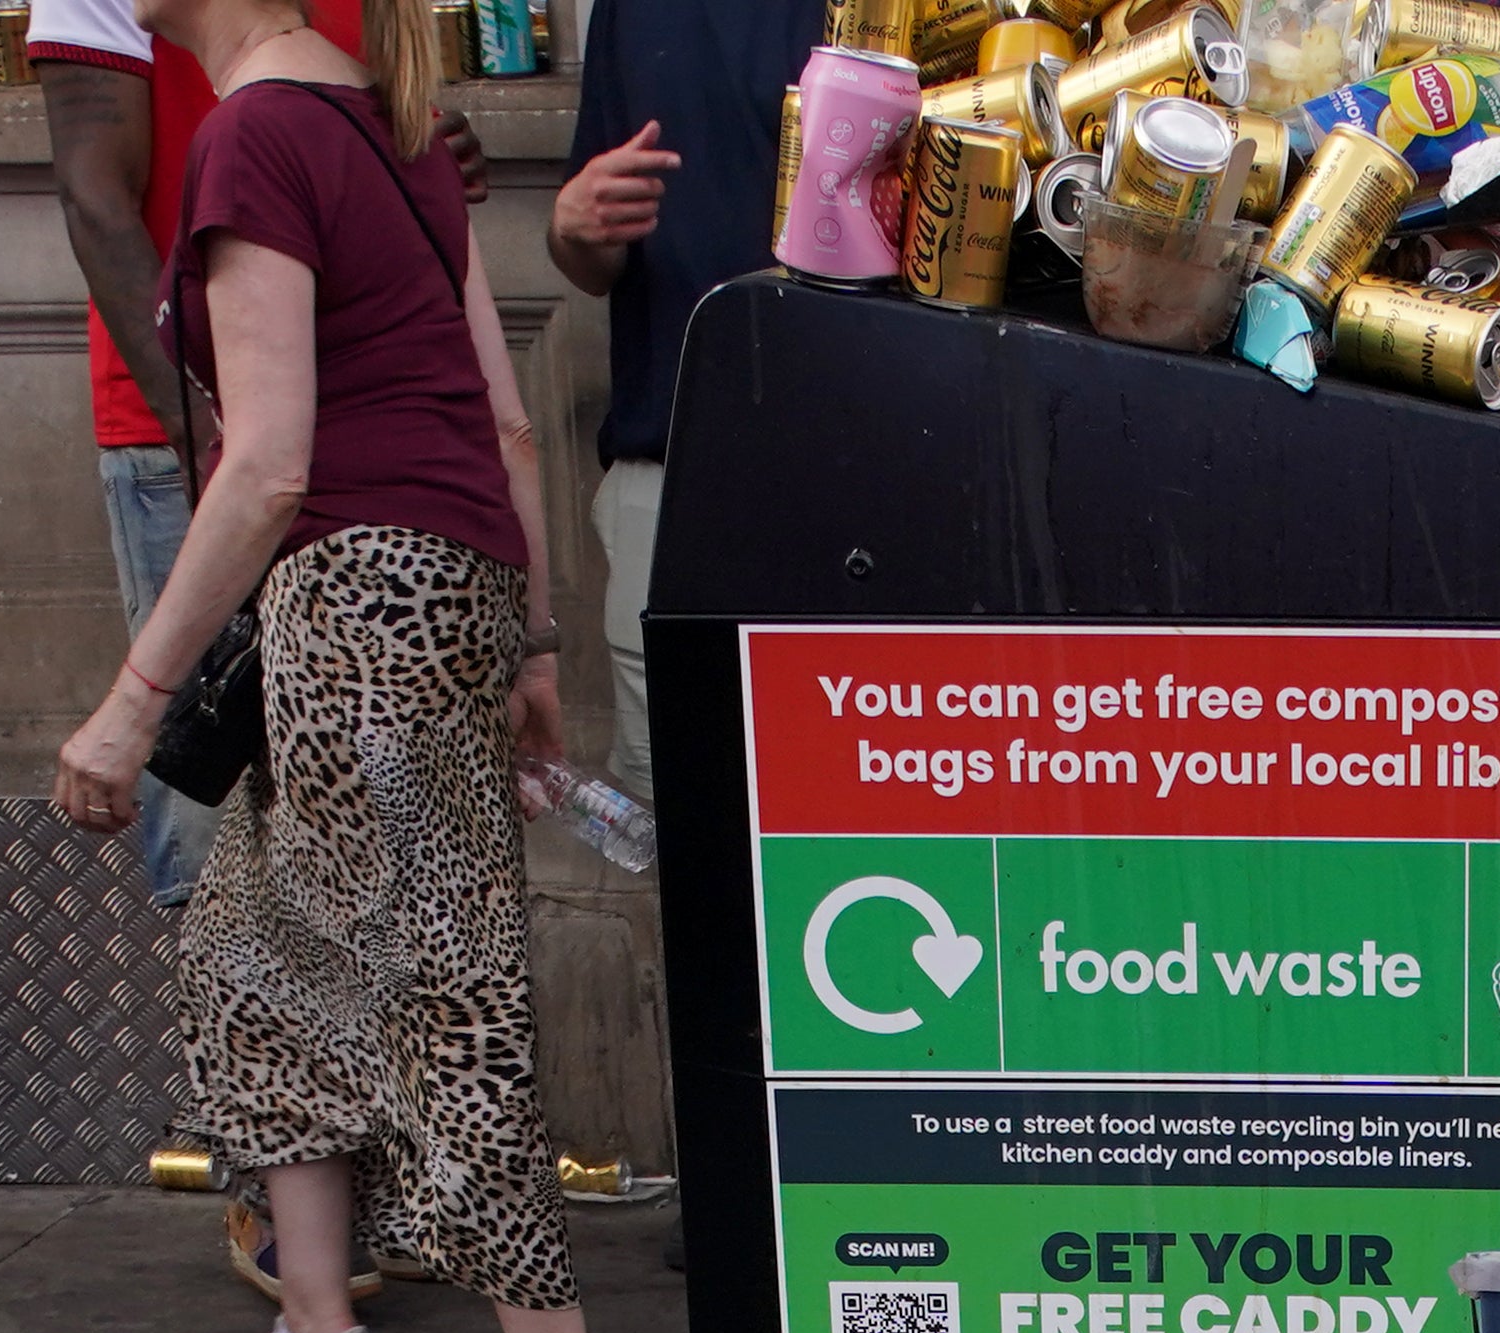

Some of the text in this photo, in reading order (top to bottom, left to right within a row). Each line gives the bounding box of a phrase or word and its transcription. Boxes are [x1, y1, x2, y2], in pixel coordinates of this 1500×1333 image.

[834, 67, 859, 83] Soda
[1413, 64, 1448, 122] Lipton
[817, 676, 923, 717] You
[936, 684, 1039, 718] can
[1052, 678, 1144, 733] get
[1154, 673, 1264, 720] free
[858, 739, 994, 797] bags
[1006, 738, 1138, 784] from
[1149, 751, 1278, 798] your
[1291, 742, 1421, 787] local
[1039, 919, 1422, 998] food waste
[911, 1113, 940, 1133] To
[945, 1117, 990, 1134] use
[994, 1117, 1012, 1134] a
[1023, 1114, 1095, 1134] street
[1099, 1113, 1156, 1135] food
[1160, 1116, 1236, 1136] waste
[1241, 1115, 1354, 1143] recycling
[1360, 1115, 1400, 1137] bin
[1002, 1141, 1473, 1172] kitchen caddy and composable liners.
[847, 1242, 935, 1258] SCAN ME!
[1040, 1231, 1393, 1286] GET YOUR
